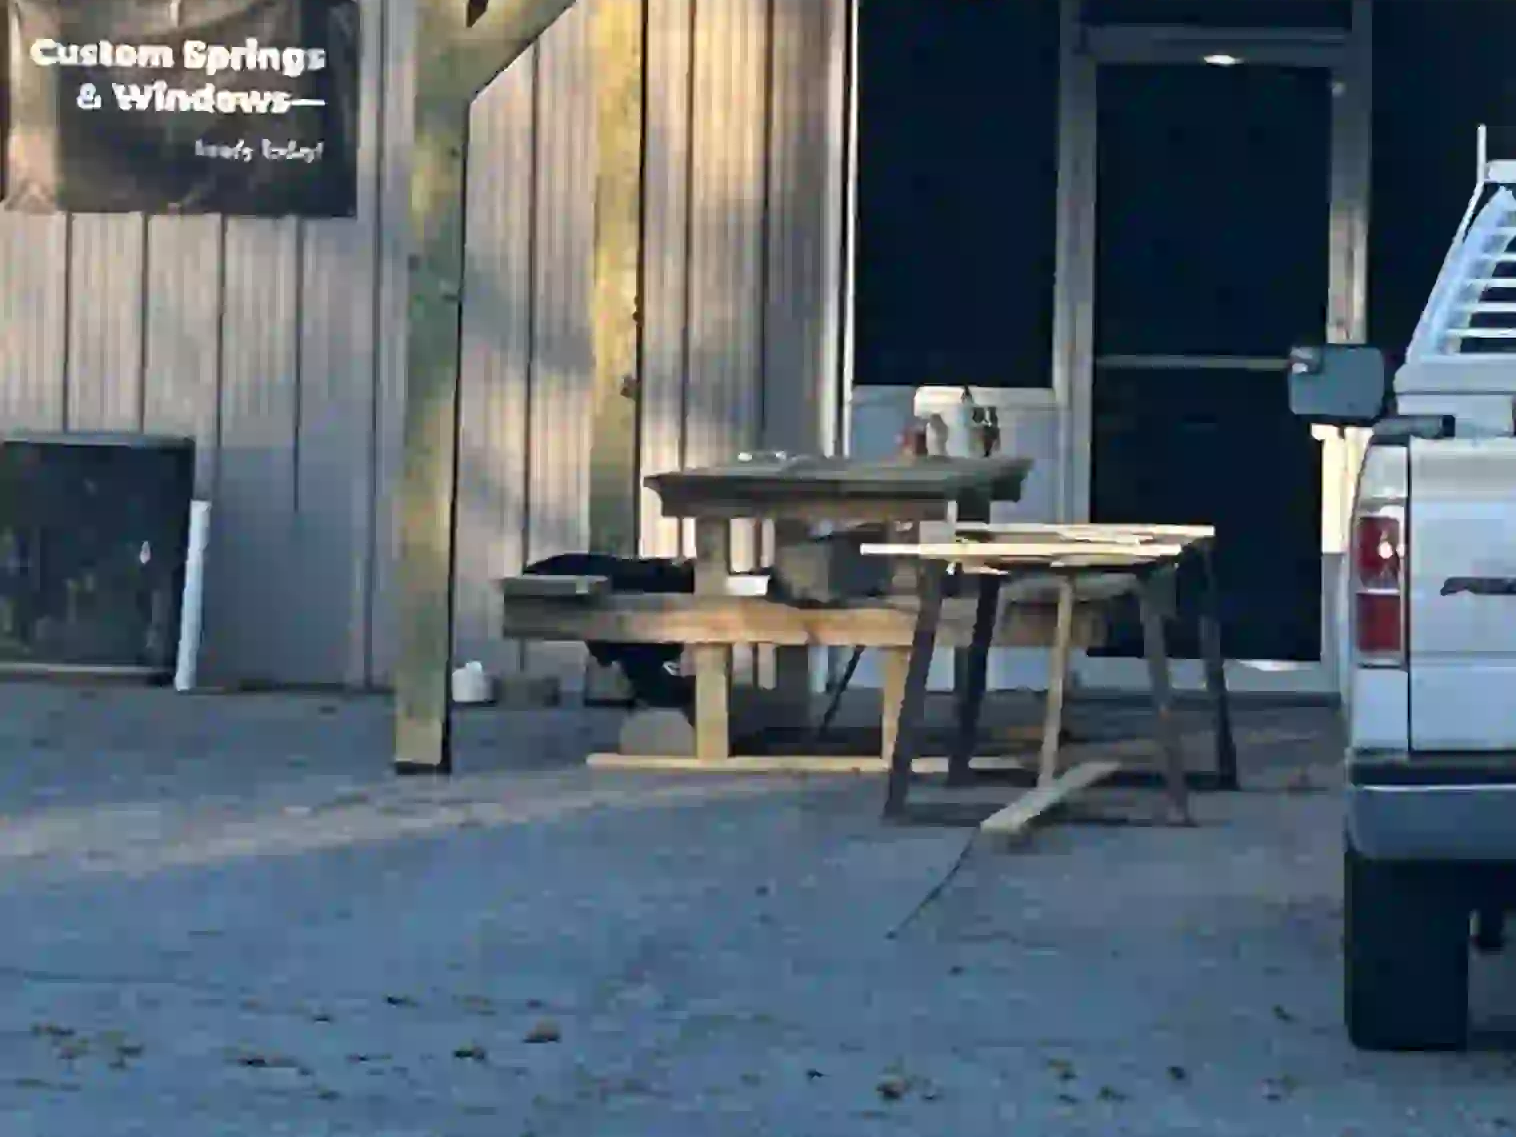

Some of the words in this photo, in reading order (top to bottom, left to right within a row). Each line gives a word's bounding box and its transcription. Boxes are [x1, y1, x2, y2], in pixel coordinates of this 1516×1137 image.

[30, 38, 174, 68] Custom
[182, 37, 326, 77] Springs
[77, 82, 101, 110] &
